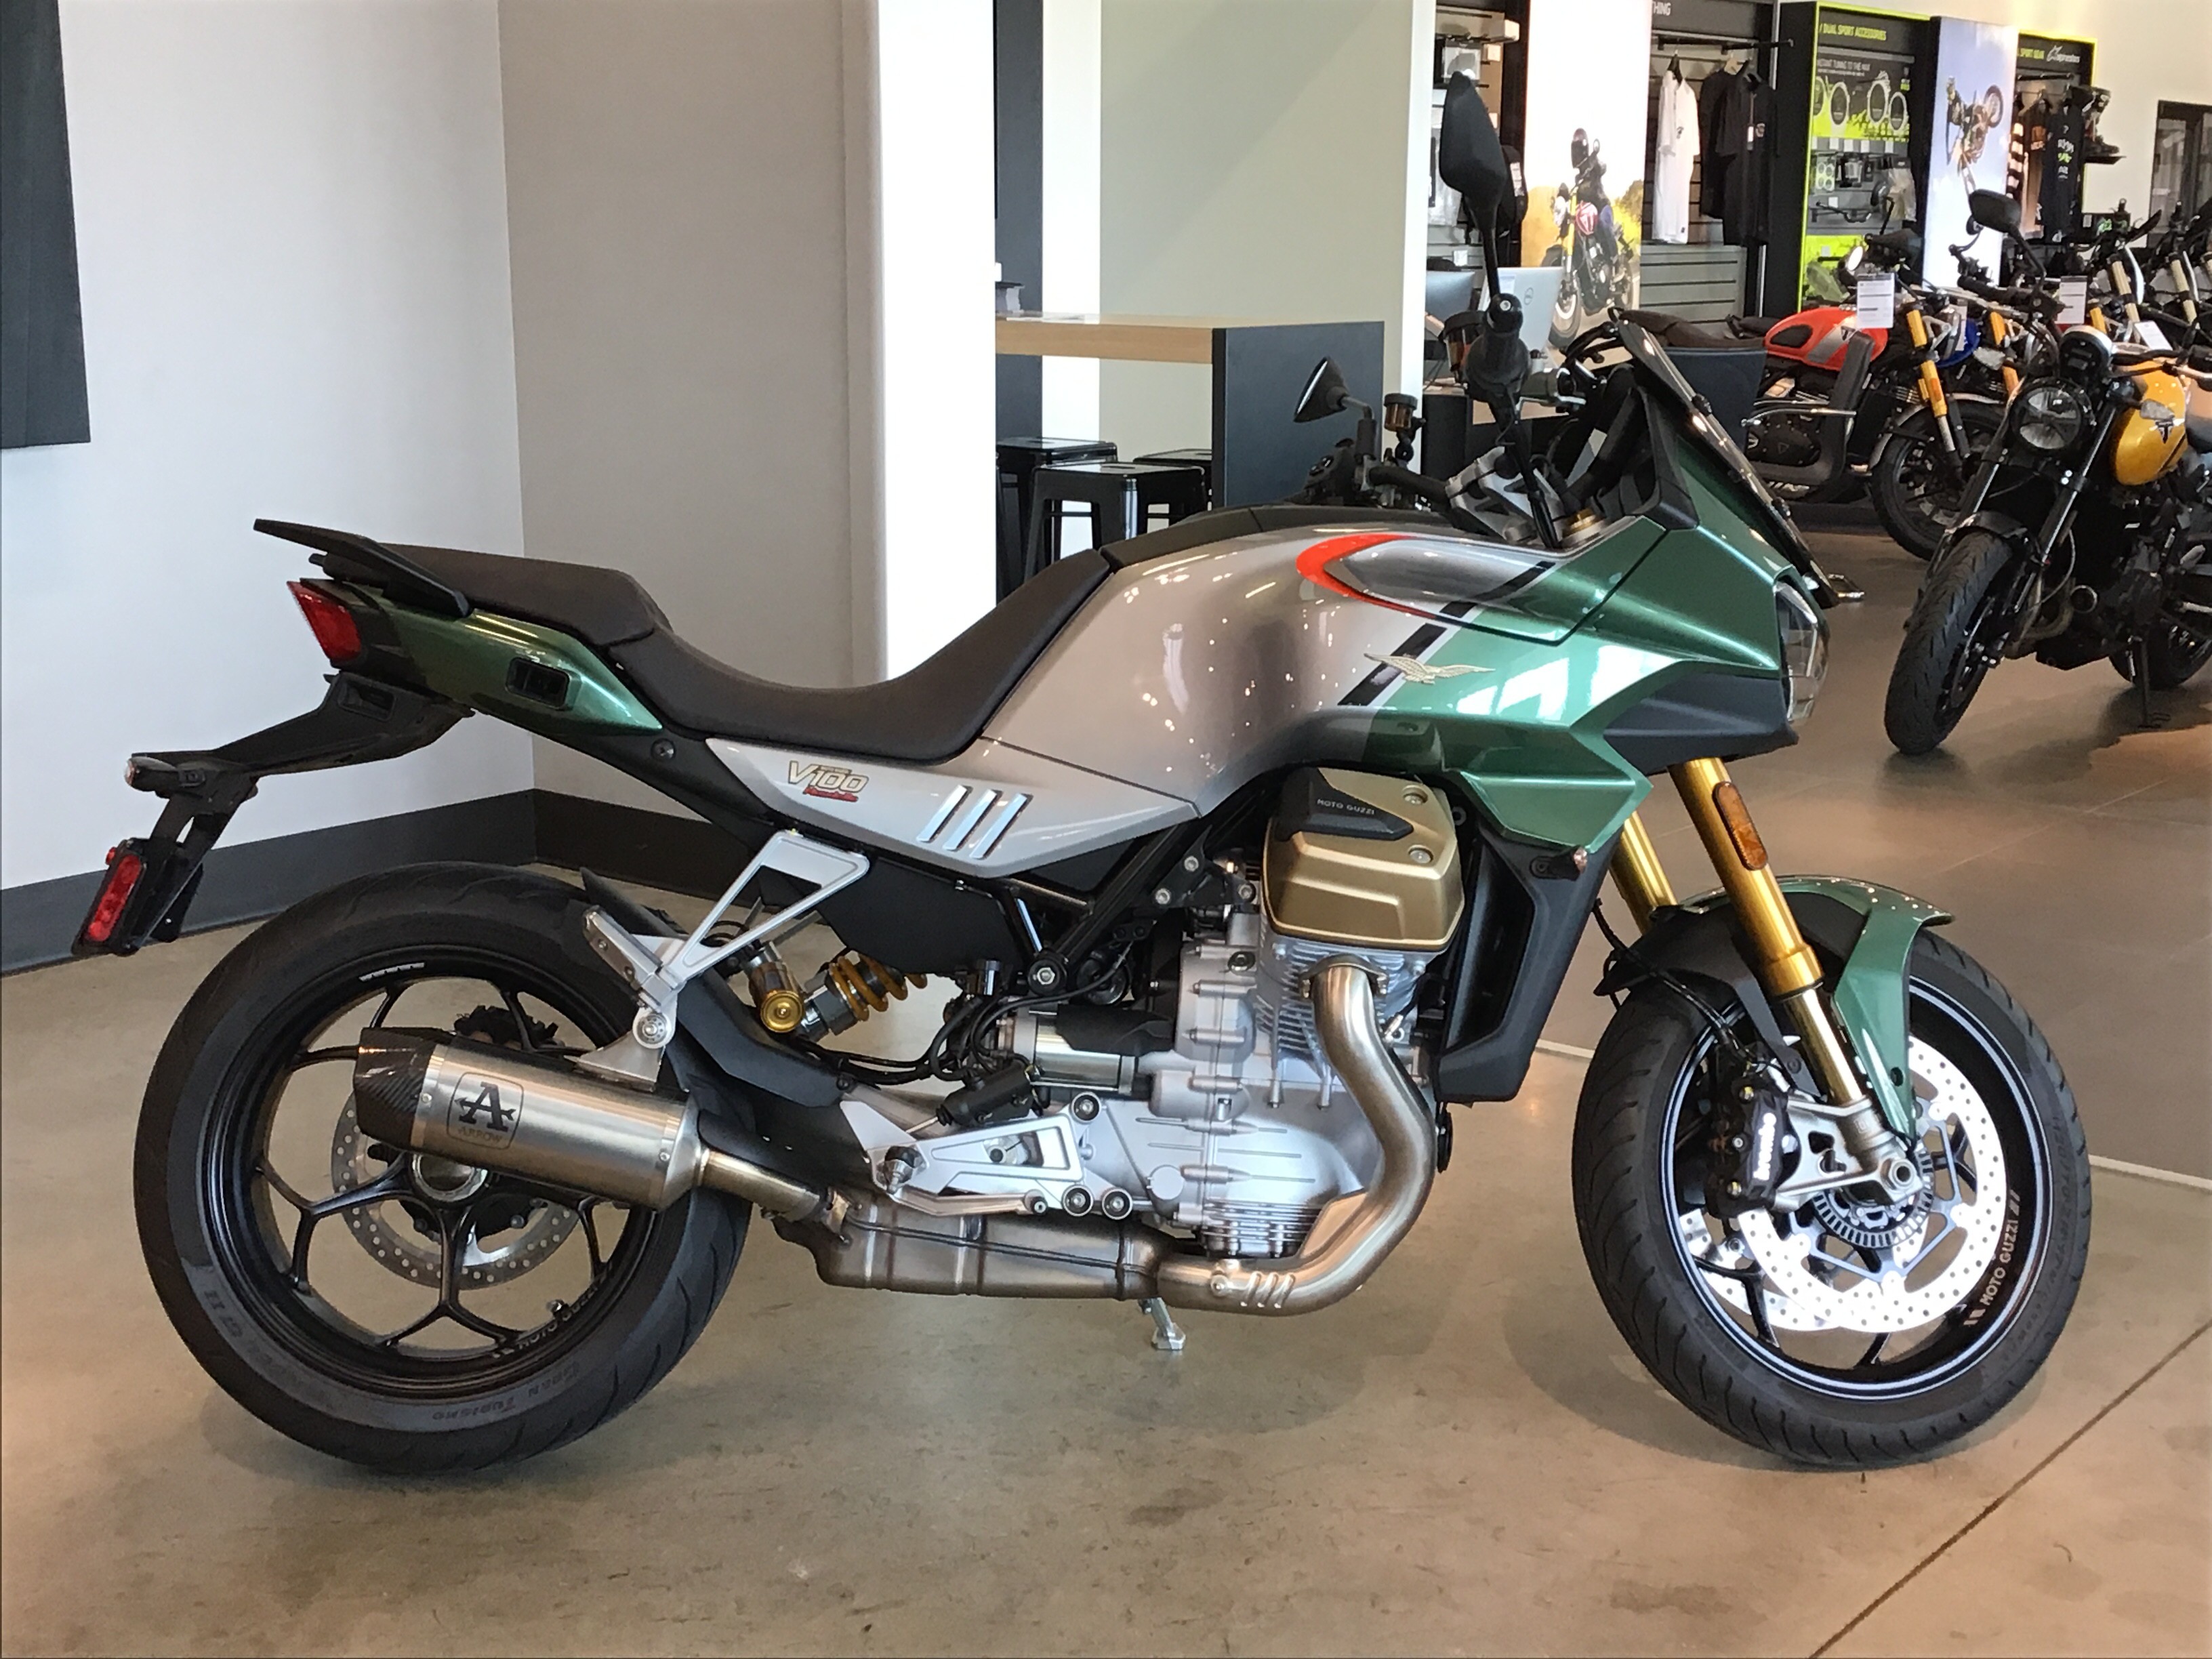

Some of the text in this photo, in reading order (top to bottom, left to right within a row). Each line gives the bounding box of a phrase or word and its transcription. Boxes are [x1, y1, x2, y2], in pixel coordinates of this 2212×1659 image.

[1652, 1, 1671, 16] HING
[788, 760, 869, 794] V100
[1317, 798, 1375, 815] MOTO GUZZI
[1980, 1219, 2019, 1306] MOTO GUZZI
